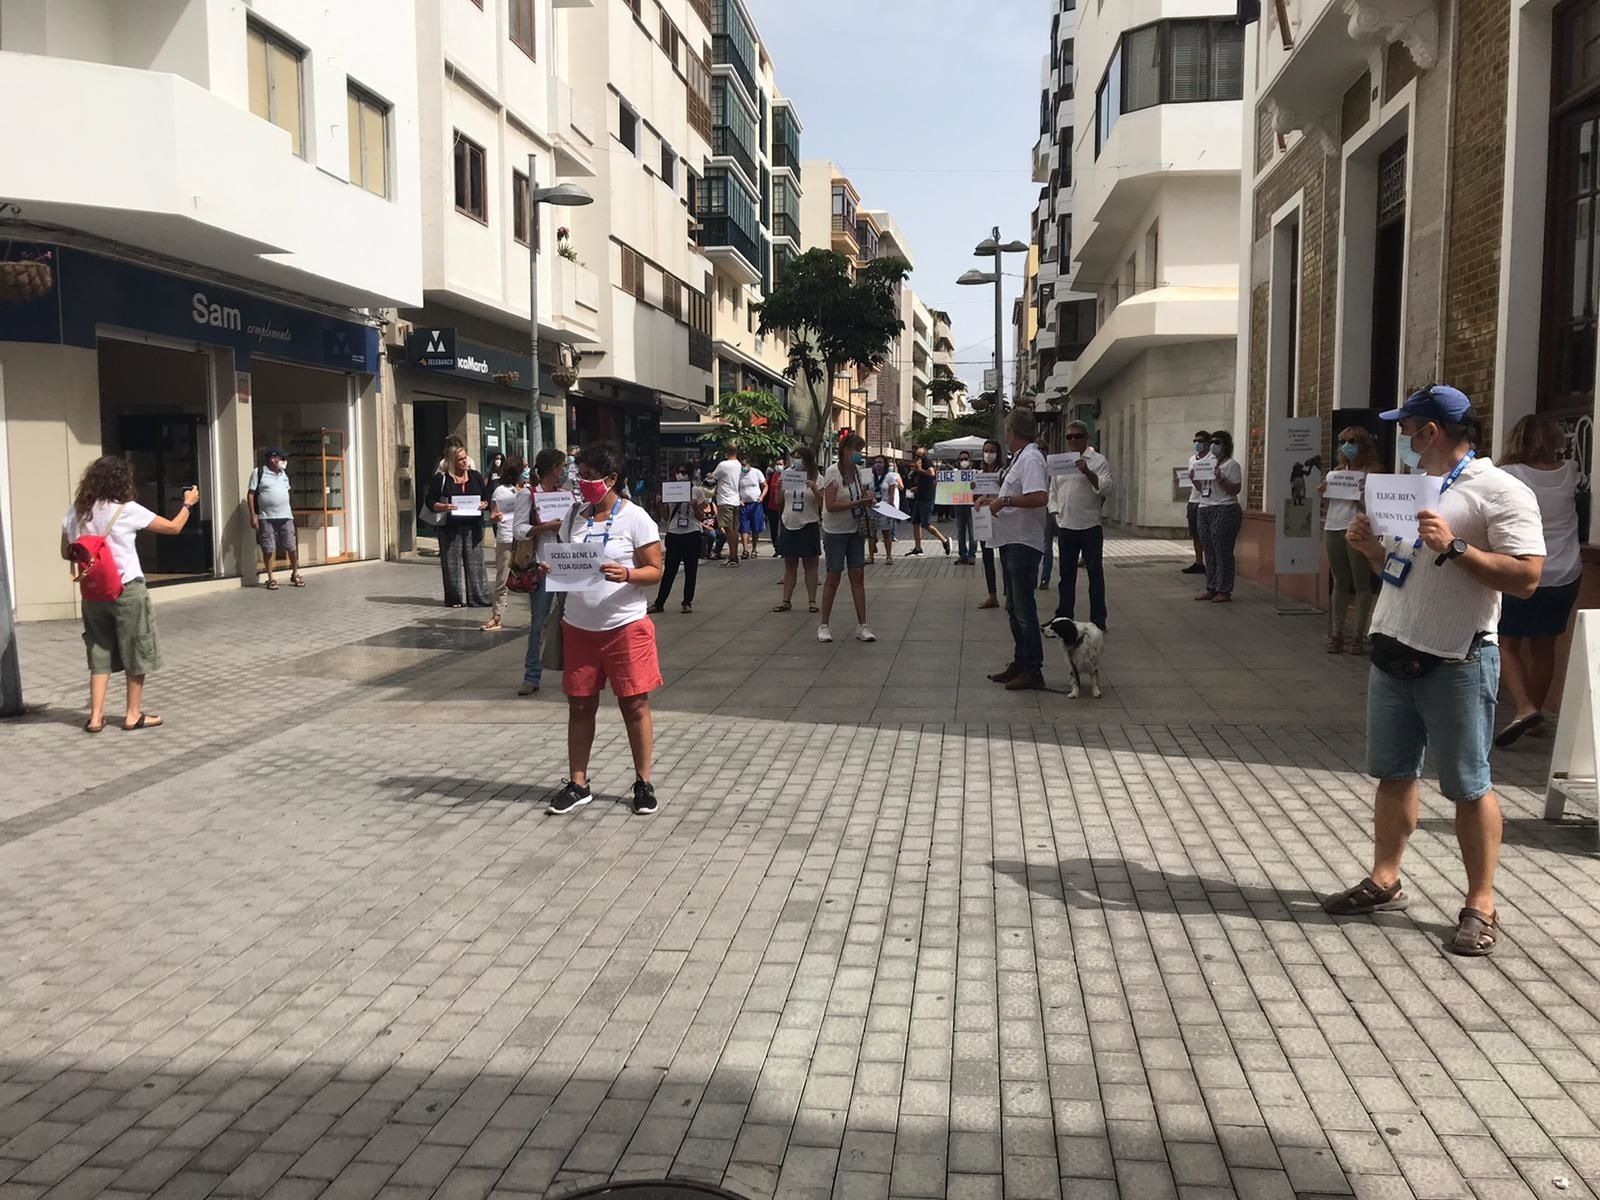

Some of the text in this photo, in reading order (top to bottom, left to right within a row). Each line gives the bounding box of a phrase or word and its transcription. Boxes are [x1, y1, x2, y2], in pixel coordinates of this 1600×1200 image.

[192, 292, 241, 331] Sam
[1376, 492, 1416, 501] ELIGE BIEN
[551, 551, 598, 560] SCEGLI BENE LA
